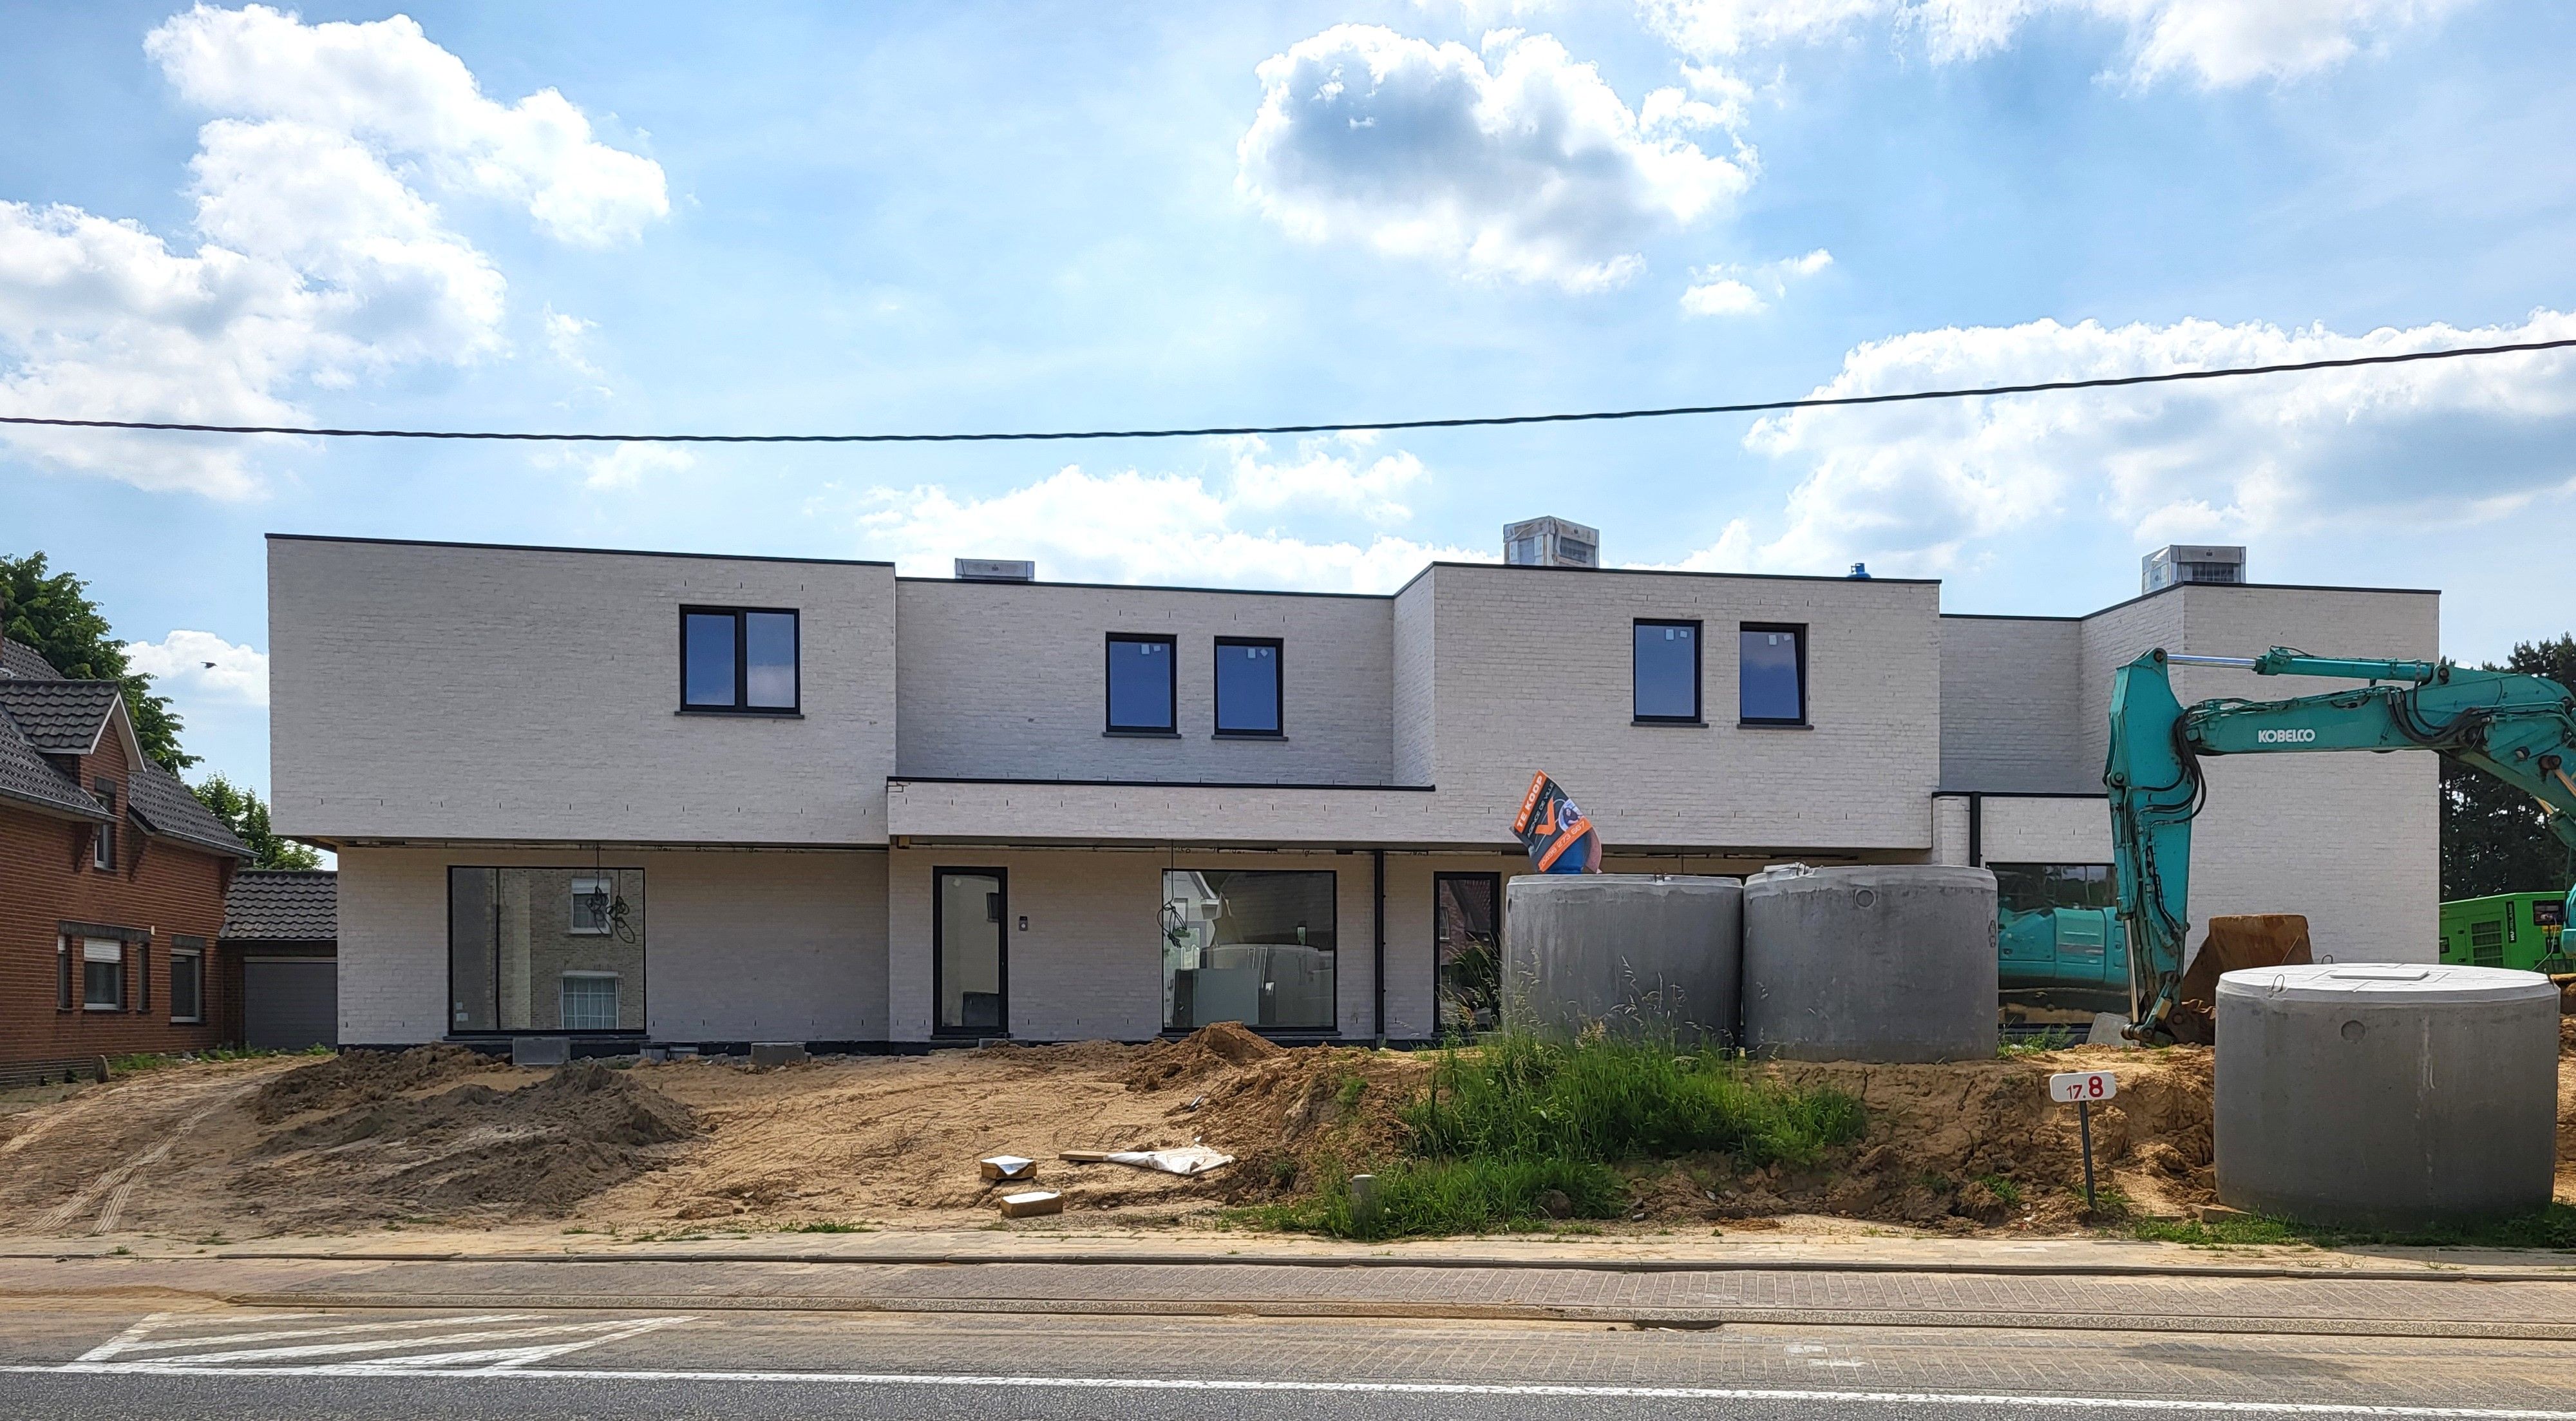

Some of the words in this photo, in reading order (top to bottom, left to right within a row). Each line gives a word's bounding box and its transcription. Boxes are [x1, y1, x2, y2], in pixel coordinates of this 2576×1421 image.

[2258, 729, 2316, 743] KOBELCO
[1517, 811, 1527, 827] TE
[1524, 775, 1543, 811] KOOP
[1527, 810, 1541, 838] AGENCE
[1539, 800, 1546, 810] DE
[1544, 782, 1555, 799] VILLE
[1557, 834, 1571, 848] 273
